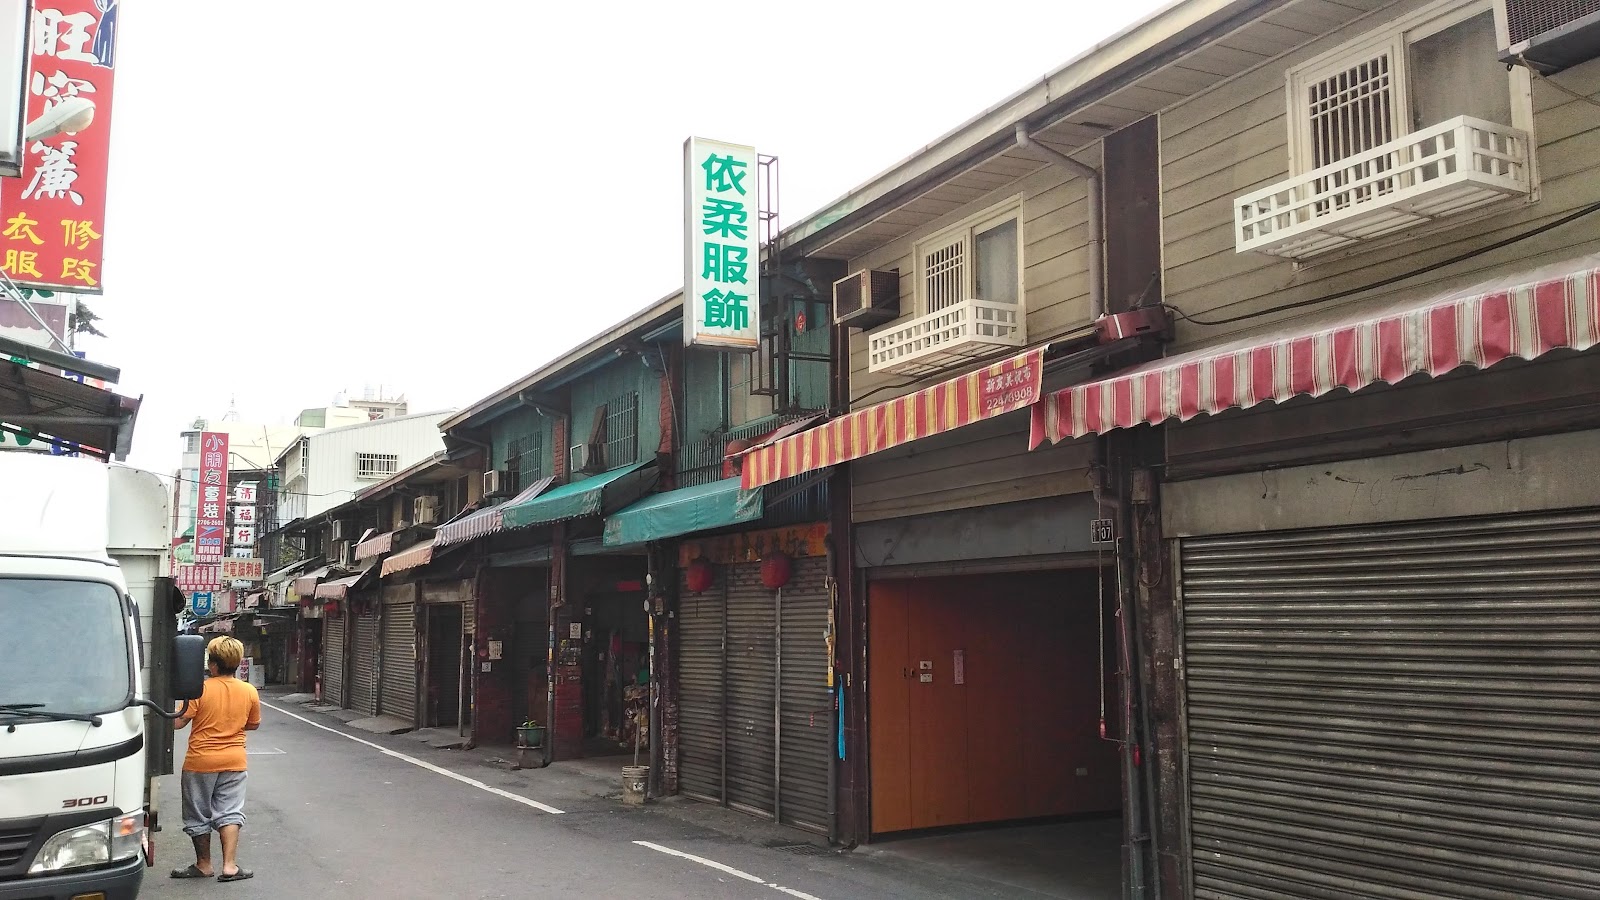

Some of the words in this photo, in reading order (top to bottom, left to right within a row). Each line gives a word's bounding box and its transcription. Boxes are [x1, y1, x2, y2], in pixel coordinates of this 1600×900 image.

[2, 212, 45, 278] 衣服
[701, 153, 748, 331] 依柔服飾
[203, 434, 224, 518] 小朋友童裝
[62, 795, 108, 808] 300
